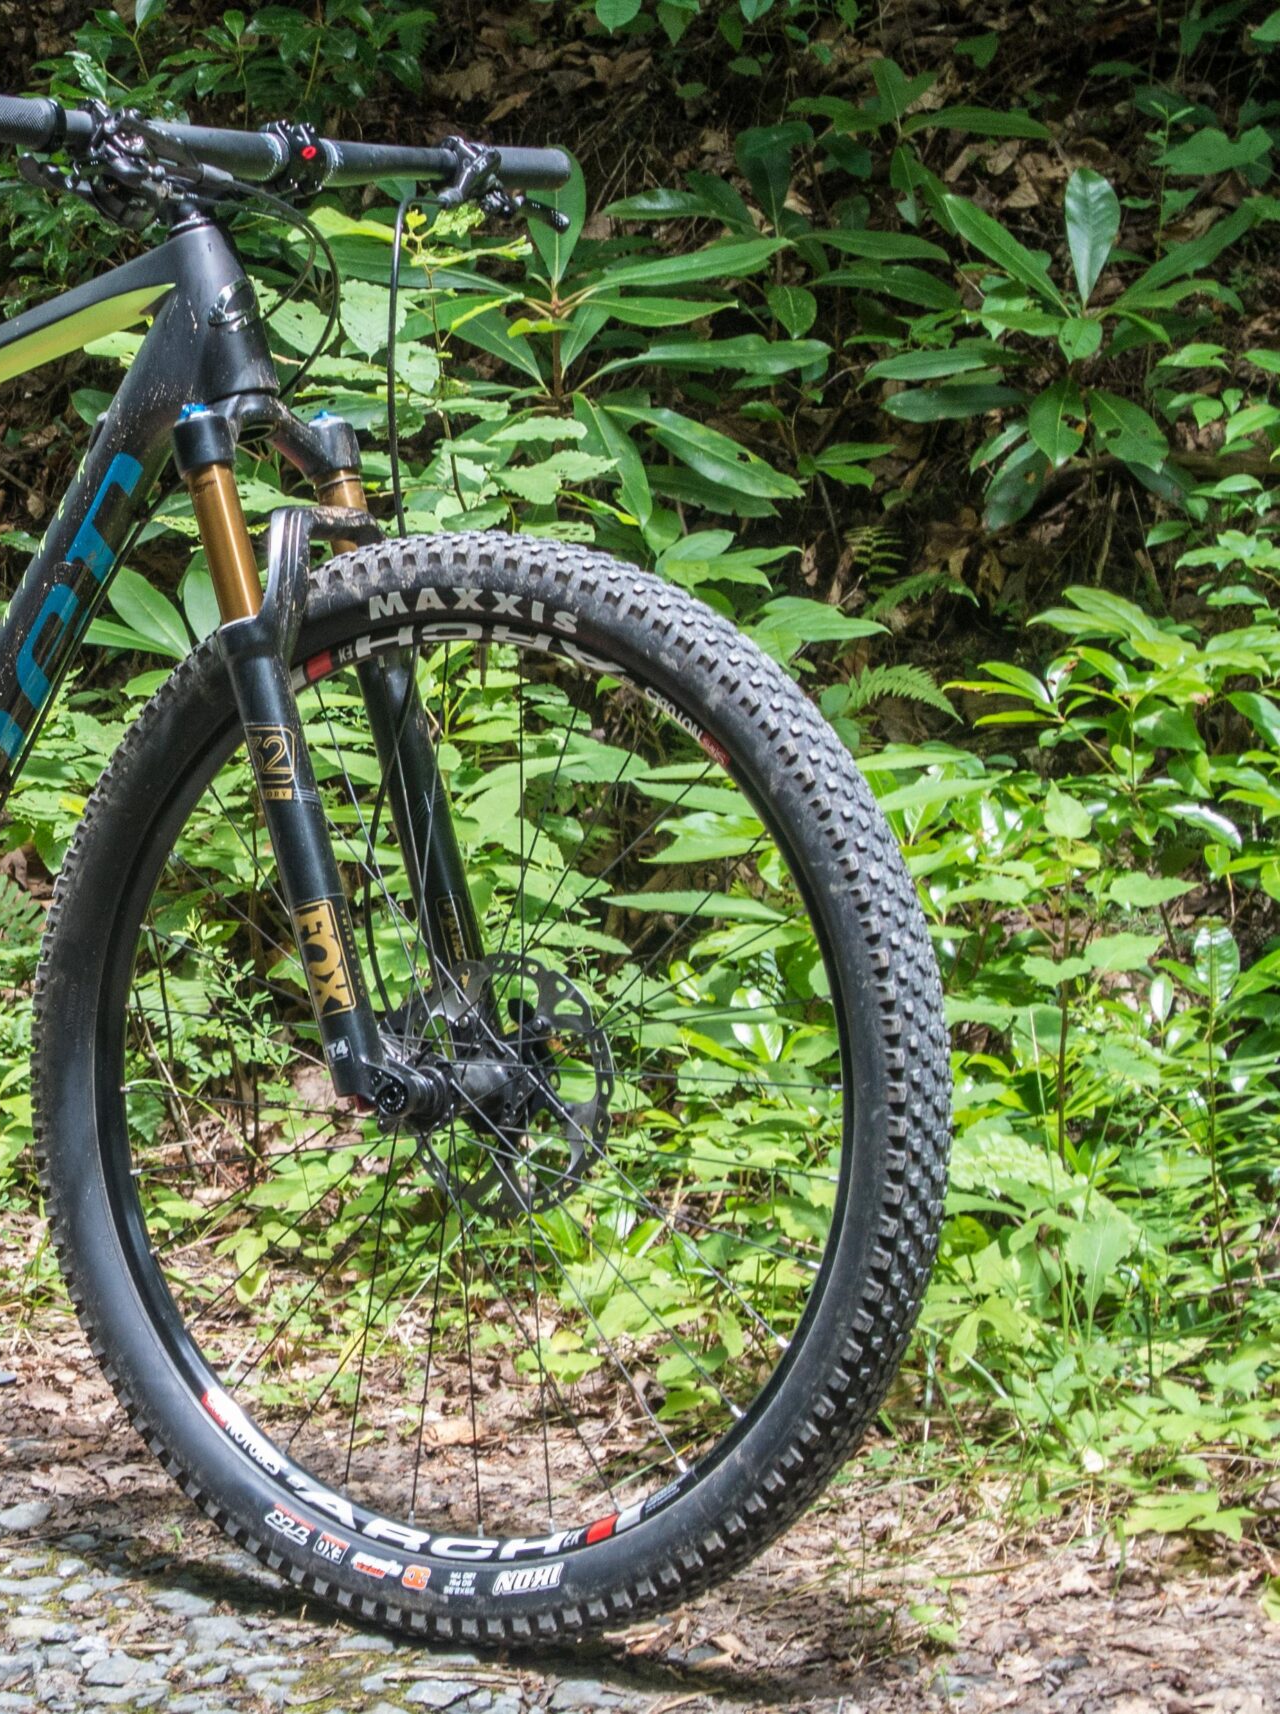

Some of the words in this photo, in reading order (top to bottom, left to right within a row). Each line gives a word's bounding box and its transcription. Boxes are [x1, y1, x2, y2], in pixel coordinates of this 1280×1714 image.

[370, 587, 577, 634] MAXXIS
[355, 621, 627, 672] ARCH
[247, 735, 293, 775] 32
[297, 904, 352, 1014] FOX
[293, 1488, 570, 1562] ARCH
[562, 1529, 585, 1547] EX
[315, 1539, 344, 1562] EXO
[492, 1562, 565, 1597] IKON
